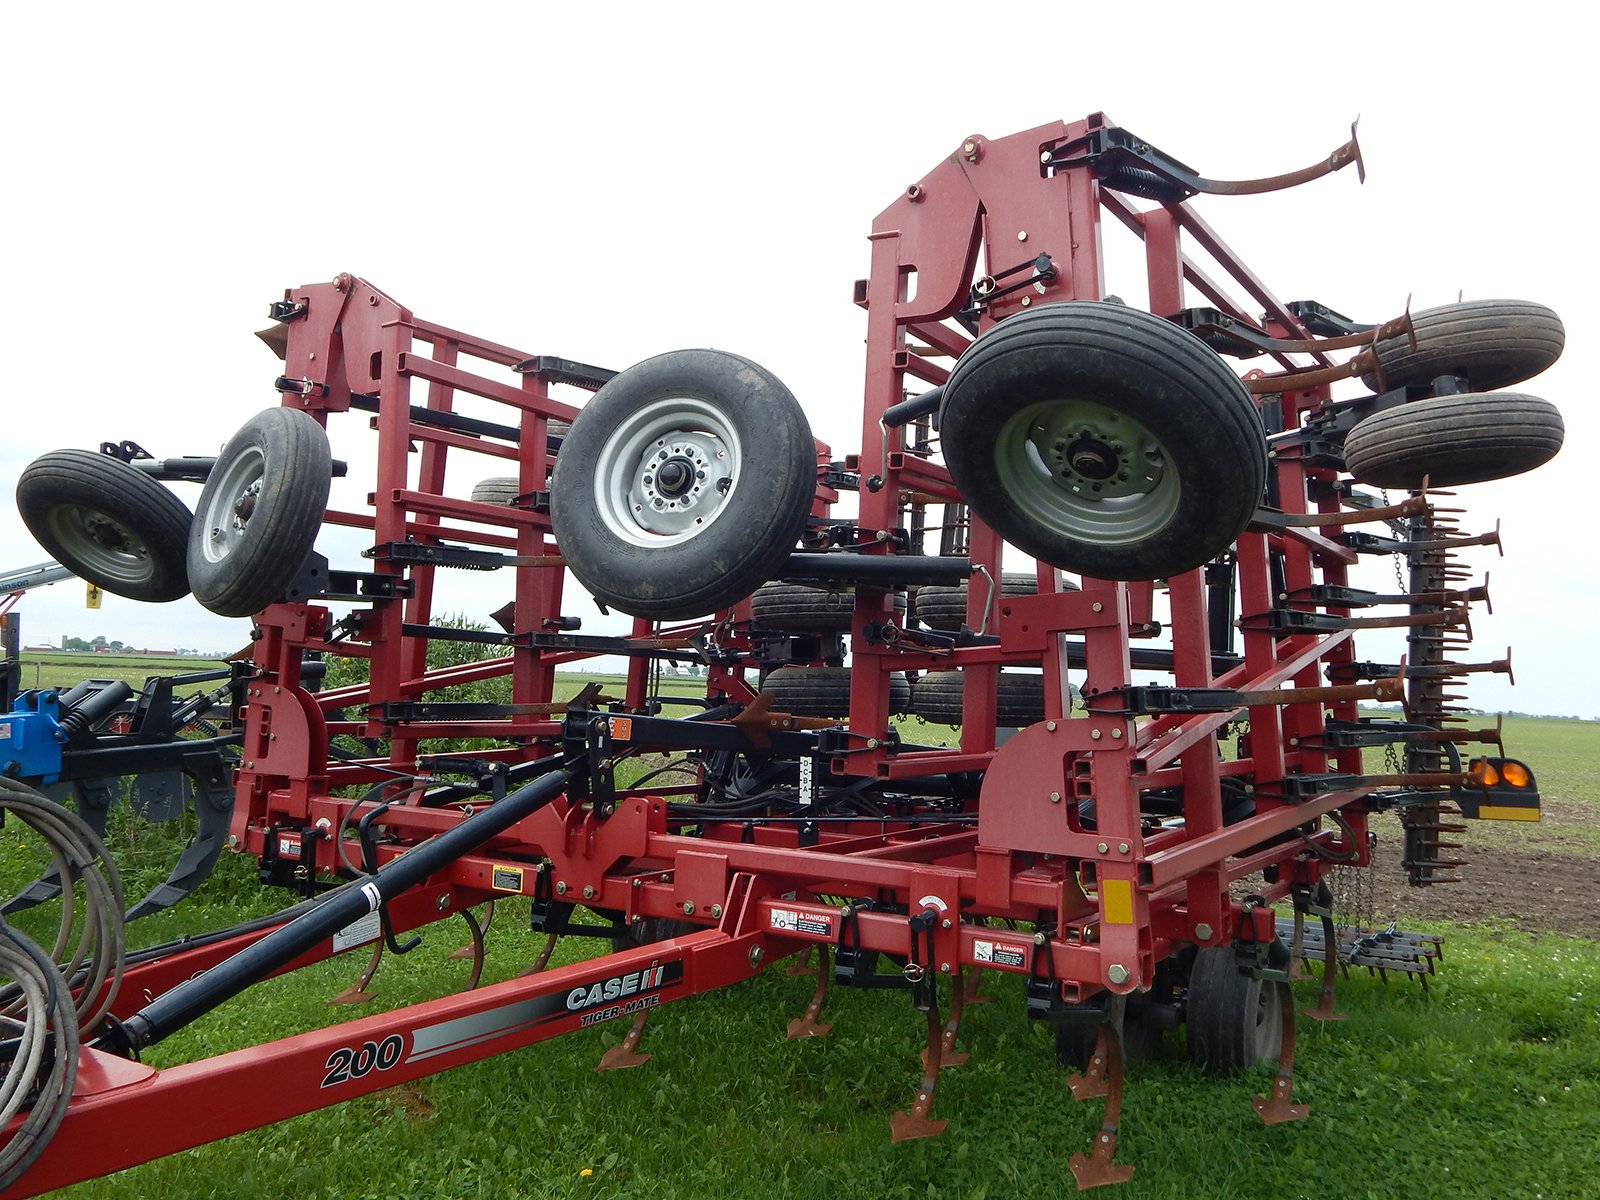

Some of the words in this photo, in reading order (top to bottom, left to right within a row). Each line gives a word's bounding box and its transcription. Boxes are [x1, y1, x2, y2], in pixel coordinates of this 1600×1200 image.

[805, 913, 831, 923] DANGER
[1002, 945, 1024, 953] DANGER
[320, 1034, 403, 1089] 200
